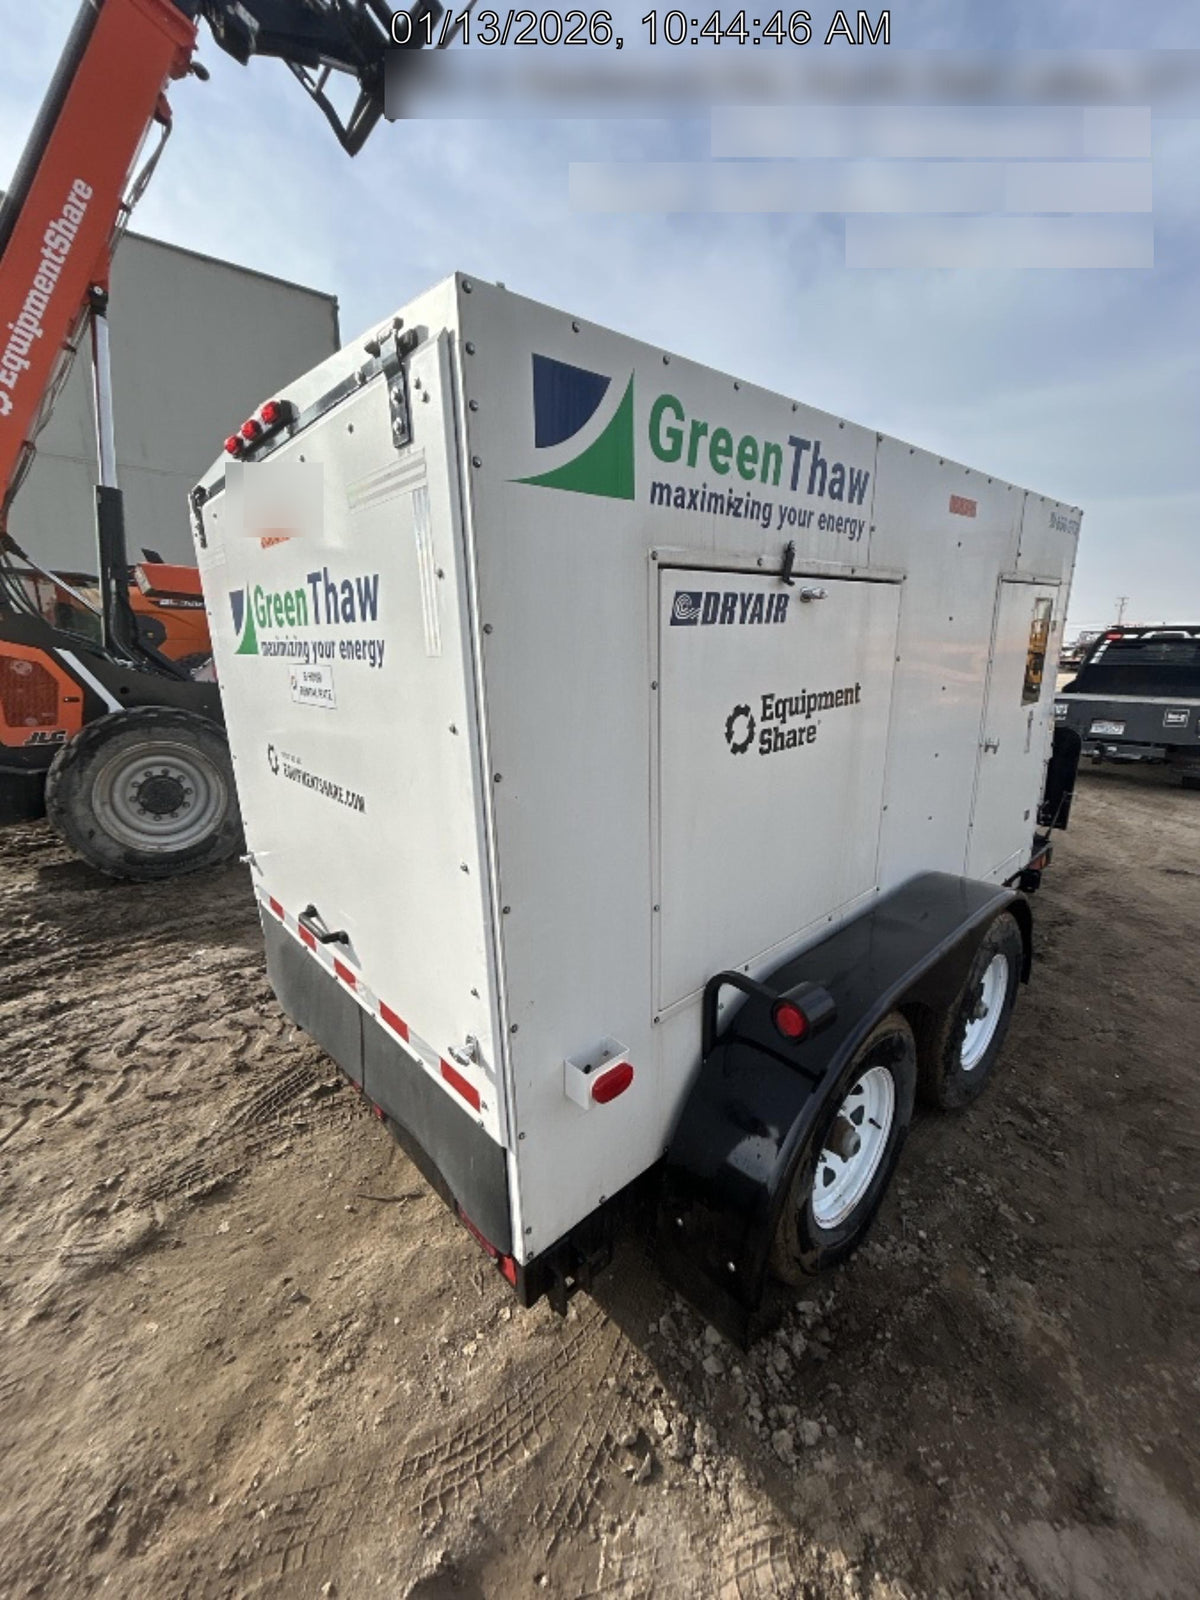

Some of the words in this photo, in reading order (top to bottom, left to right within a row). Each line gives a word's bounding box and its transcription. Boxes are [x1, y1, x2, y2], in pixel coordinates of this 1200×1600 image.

[0, 178, 93, 389] EquipmentShare
[650, 481, 773, 528] maximizing
[777, 504, 815, 531] your
[818, 512, 866, 542] energy
[701, 592, 790, 625] DRYAIR
[311, 640, 336, 664] your
[339, 639, 385, 668] energy
[760, 682, 861, 724] Equipment
[25, 731, 67, 745] JLG
[759, 722, 817, 756] Share
